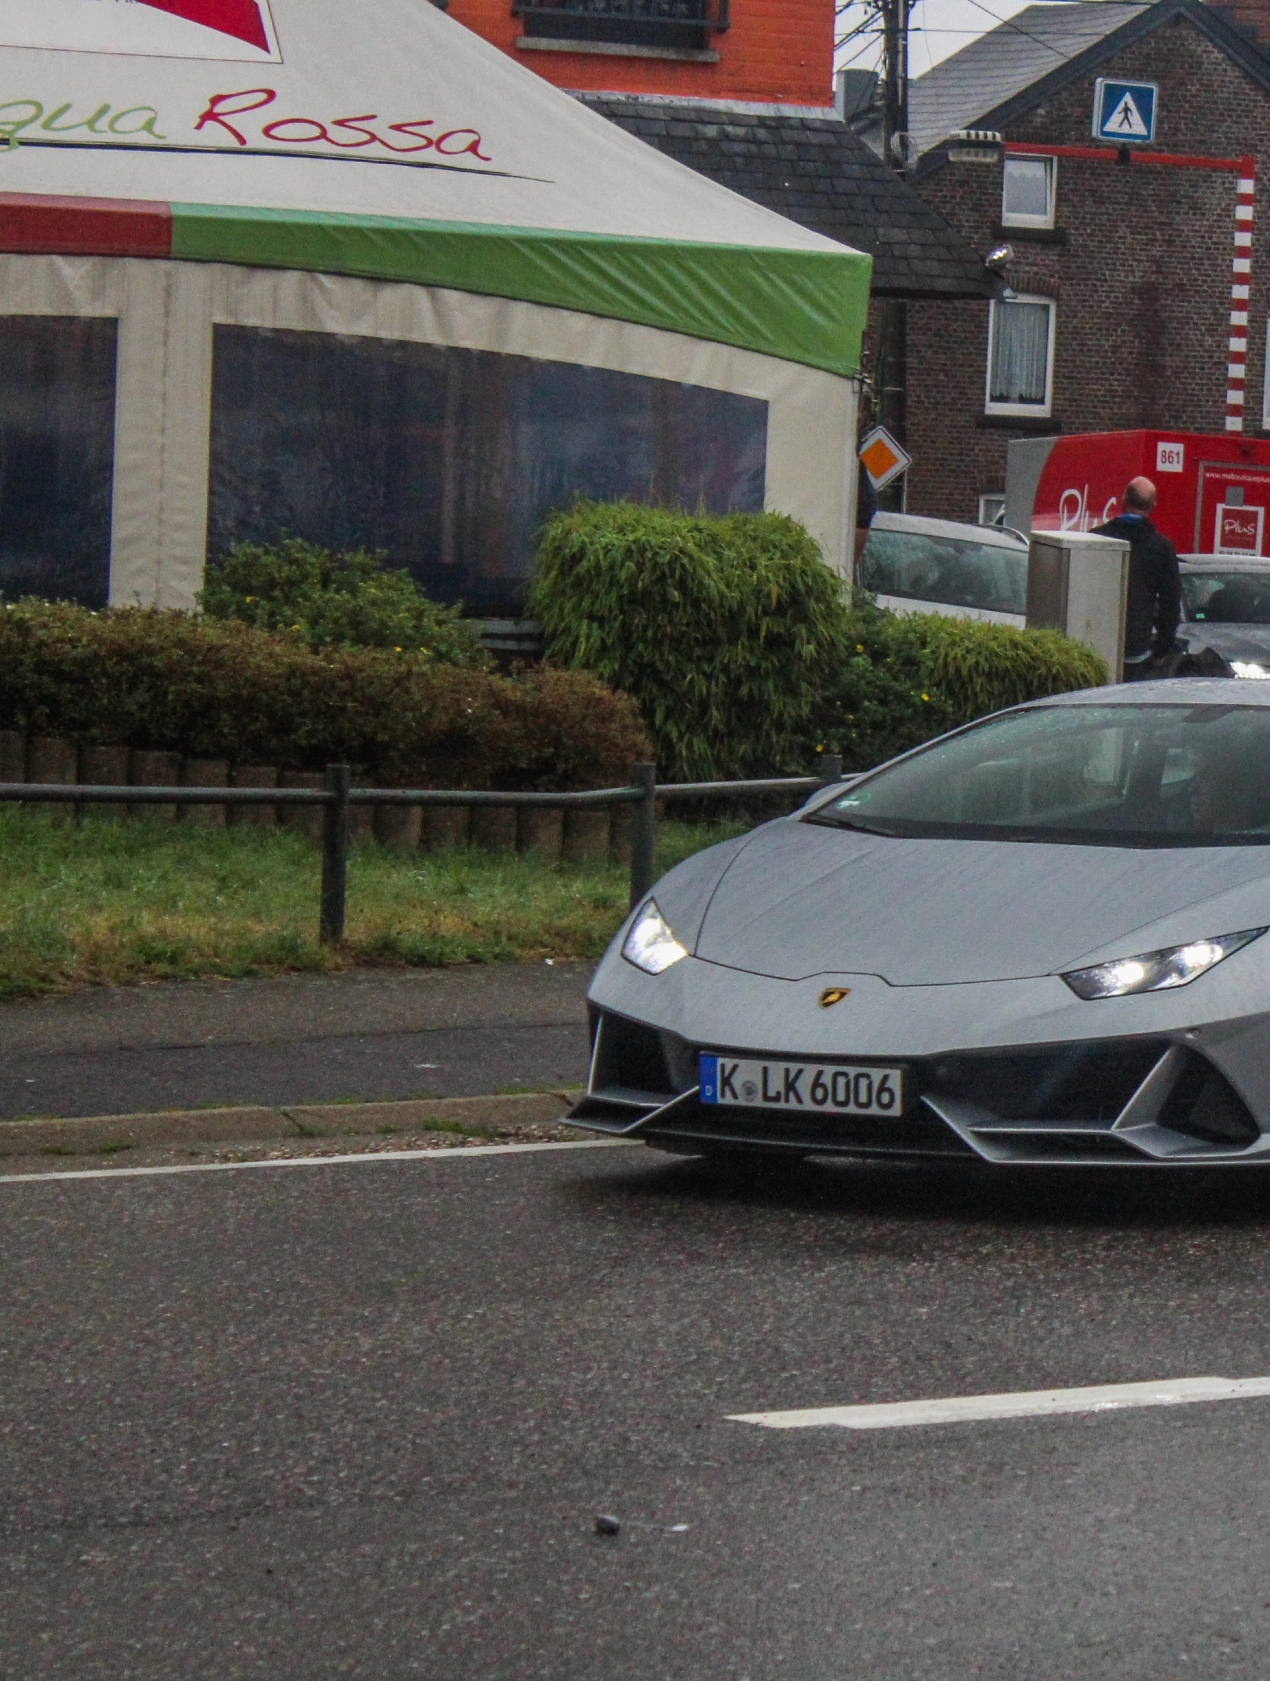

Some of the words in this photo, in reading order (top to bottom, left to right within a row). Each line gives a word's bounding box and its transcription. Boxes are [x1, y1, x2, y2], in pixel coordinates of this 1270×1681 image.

[0, 99, 167, 152] qua
[193, 88, 492, 162] Rossa
[1160, 449, 1181, 465] 861
[1223, 519, 1256, 536] Plus
[719, 1063, 740, 1100] K
